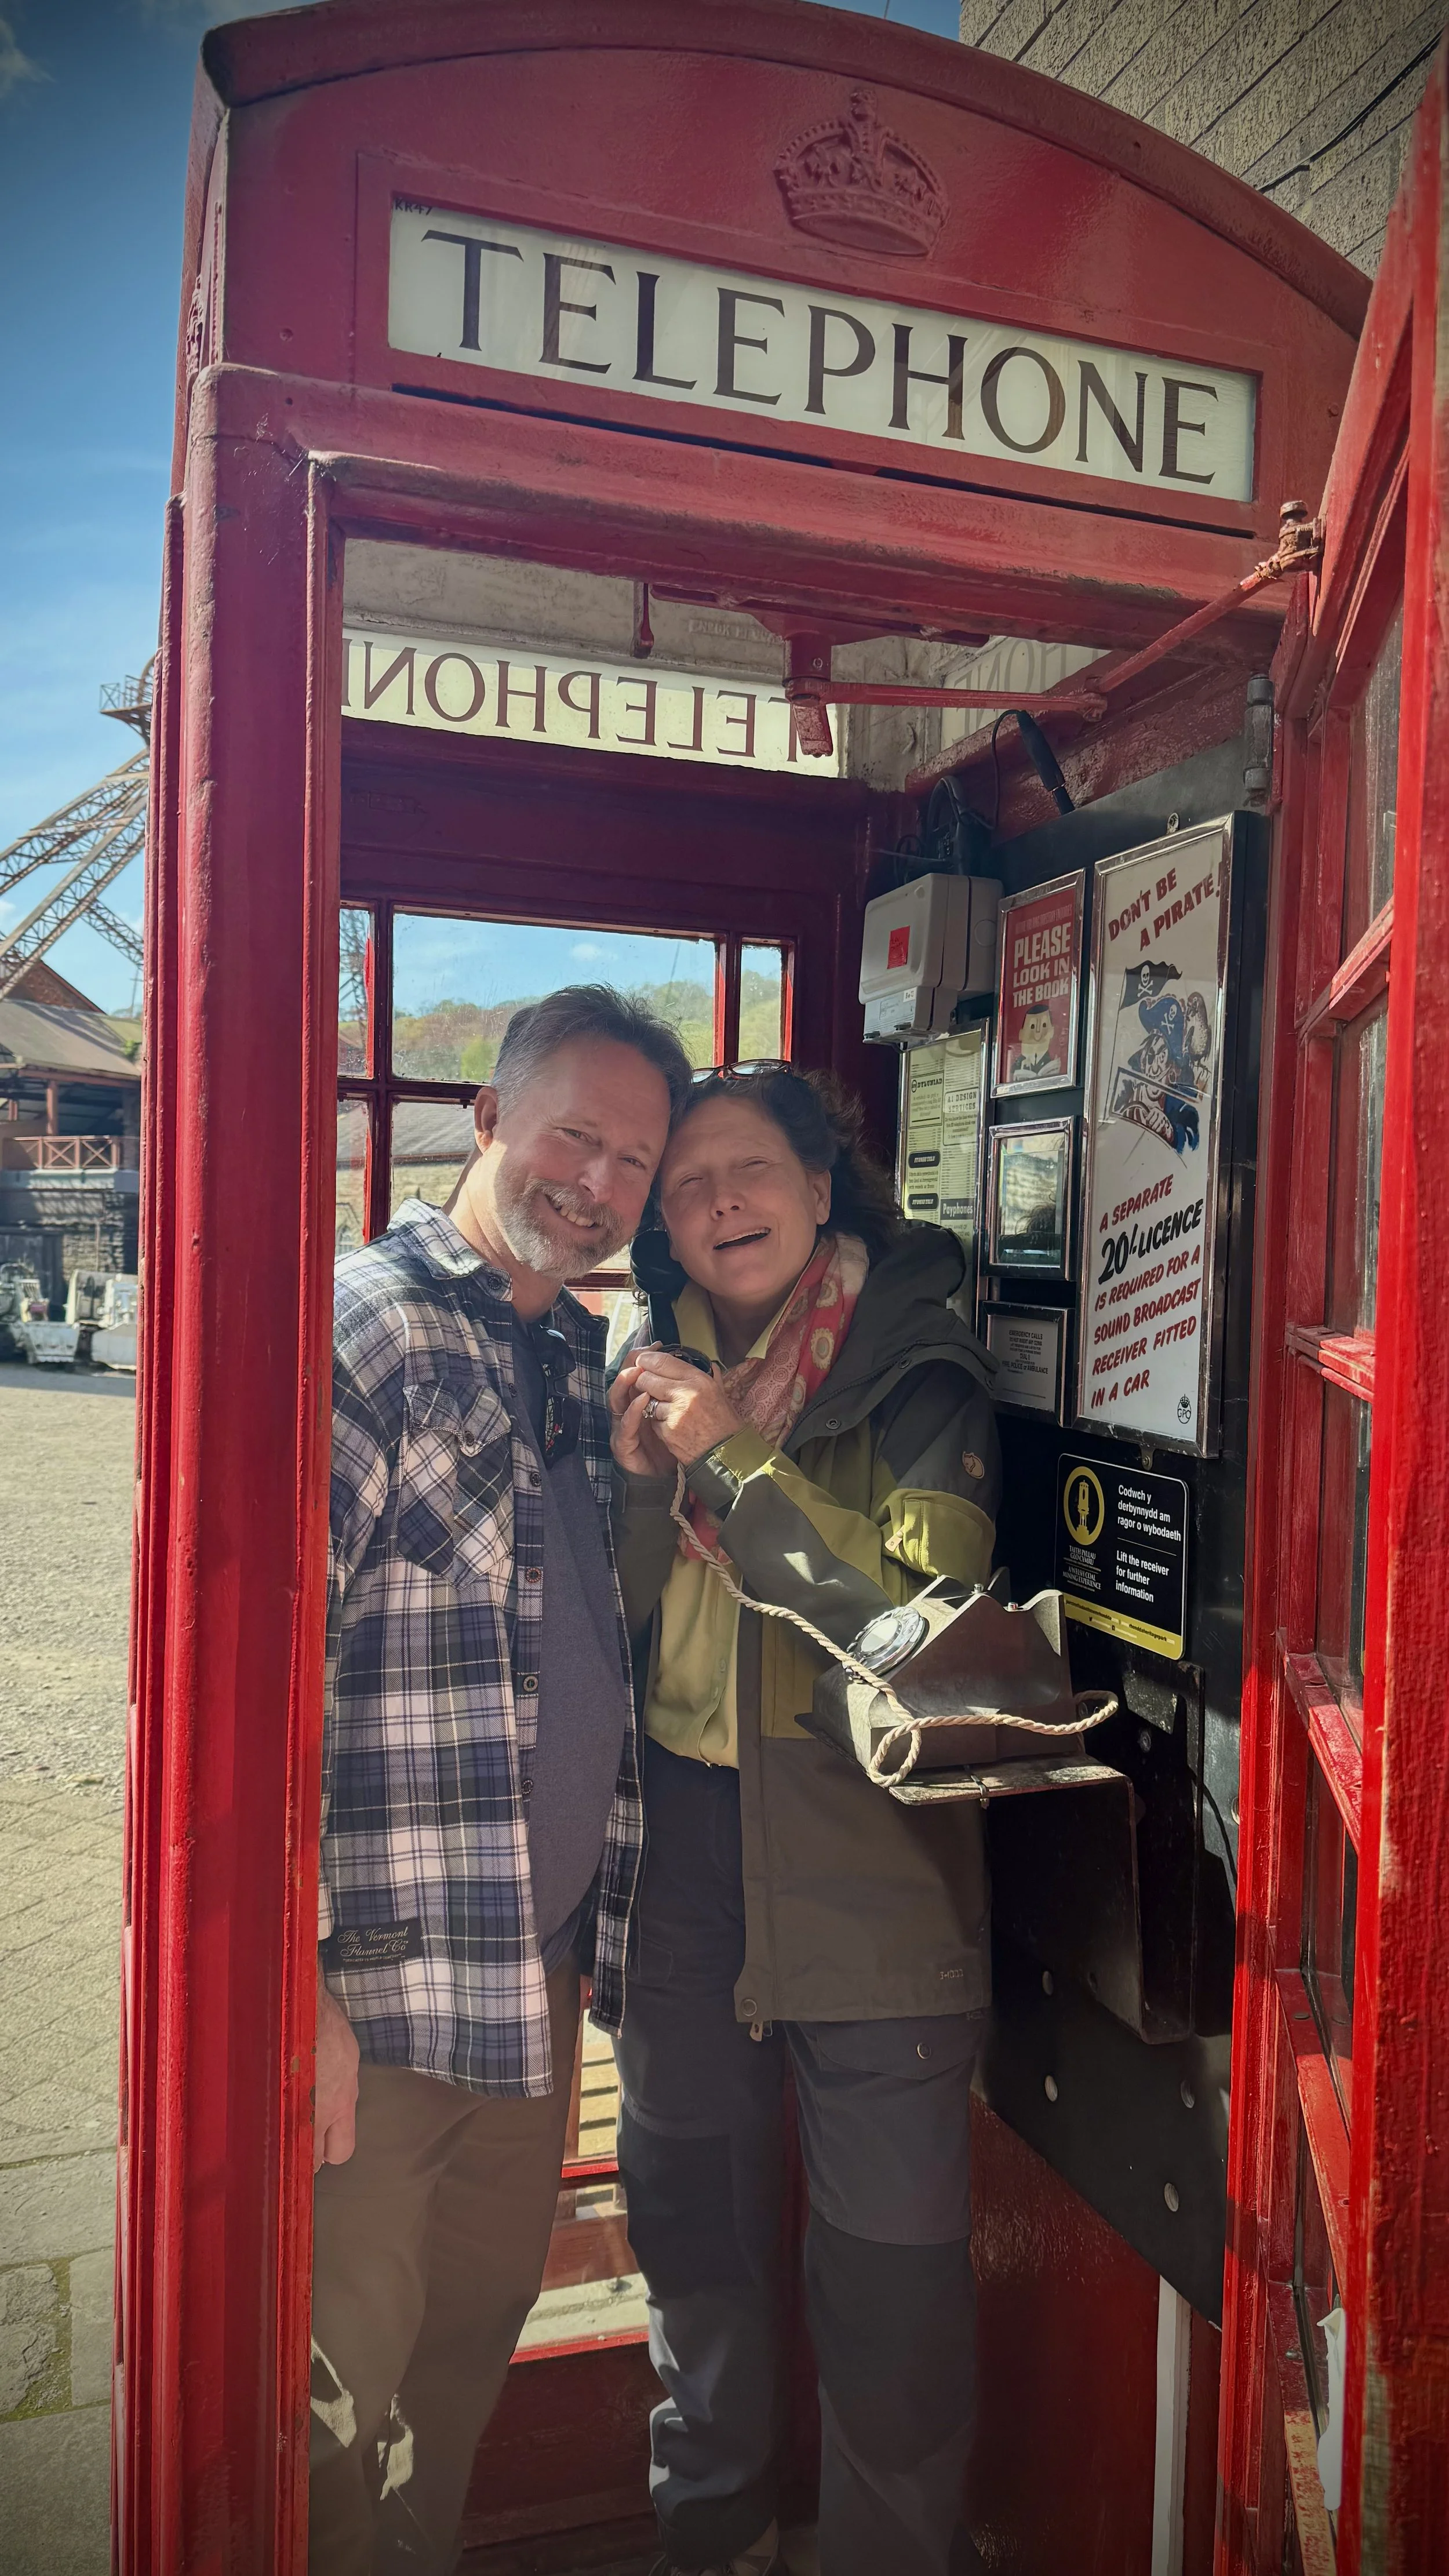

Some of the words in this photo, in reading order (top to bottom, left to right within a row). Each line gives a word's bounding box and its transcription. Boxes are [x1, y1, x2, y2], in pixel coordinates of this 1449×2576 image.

[421, 230, 1219, 484] TELEPHONE
[1108, 887, 1151, 941] DON'T
[1157, 868, 1177, 901] BE
[1014, 922, 1071, 968] PLEASE
[1139, 927, 1151, 951] A
[1013, 963, 1049, 988] LOOK
[1054, 956, 1070, 976] IN
[1013, 988, 1033, 1009] THE
[1035, 977, 1069, 1002] BOOK
[956, 1091, 977, 1101] DESIGN
[943, 1202, 973, 1217] Payphones
[1100, 1212, 1108, 1233] A
[1112, 1174, 1173, 1226] SEPARATE
[1138, 1198, 1203, 1259] LICENCE
[1094, 1291, 1106, 1312] IS
[1109, 1262, 1164, 1305] REQUIRED
[1167, 1253, 1188, 1278] FOR
[1191, 1245, 1200, 1264] A
[1094, 1312, 1130, 1345] SOUND
[1133, 1278, 1201, 1327] BROADCAST
[1093, 1337, 1146, 1376] RECEIVER
[1153, 1316, 1196, 1350] FITTED
[1091, 1387, 1105, 1409] IN
[1108, 1382, 1119, 1402] A
[1123, 1369, 1150, 1397] CAR
[1119, 1485, 1145, 1501] Codwch
[1146, 1493, 1152, 1504] y
[1118, 1500, 1157, 1520] derbynnydd
[1159, 1512, 1170, 1522] am
[1117, 1516, 1135, 1529] ragor
[1137, 1522, 1141, 1530] o
[1143, 1522, 1181, 1542] wybodaeth
[1116, 1550, 1128, 1563] Lift
[1128, 1554, 1139, 1567] the
[1141, 1560, 1169, 1576] receiver
[1116, 1565, 1126, 1577] for
[1127, 1569, 1150, 1585] further
[1116, 1580, 1154, 1603] information
[337, 1930, 361, 1943] The
[365, 1926, 408, 1942] Vermont
[340, 1943, 388, 1957] Flannel
